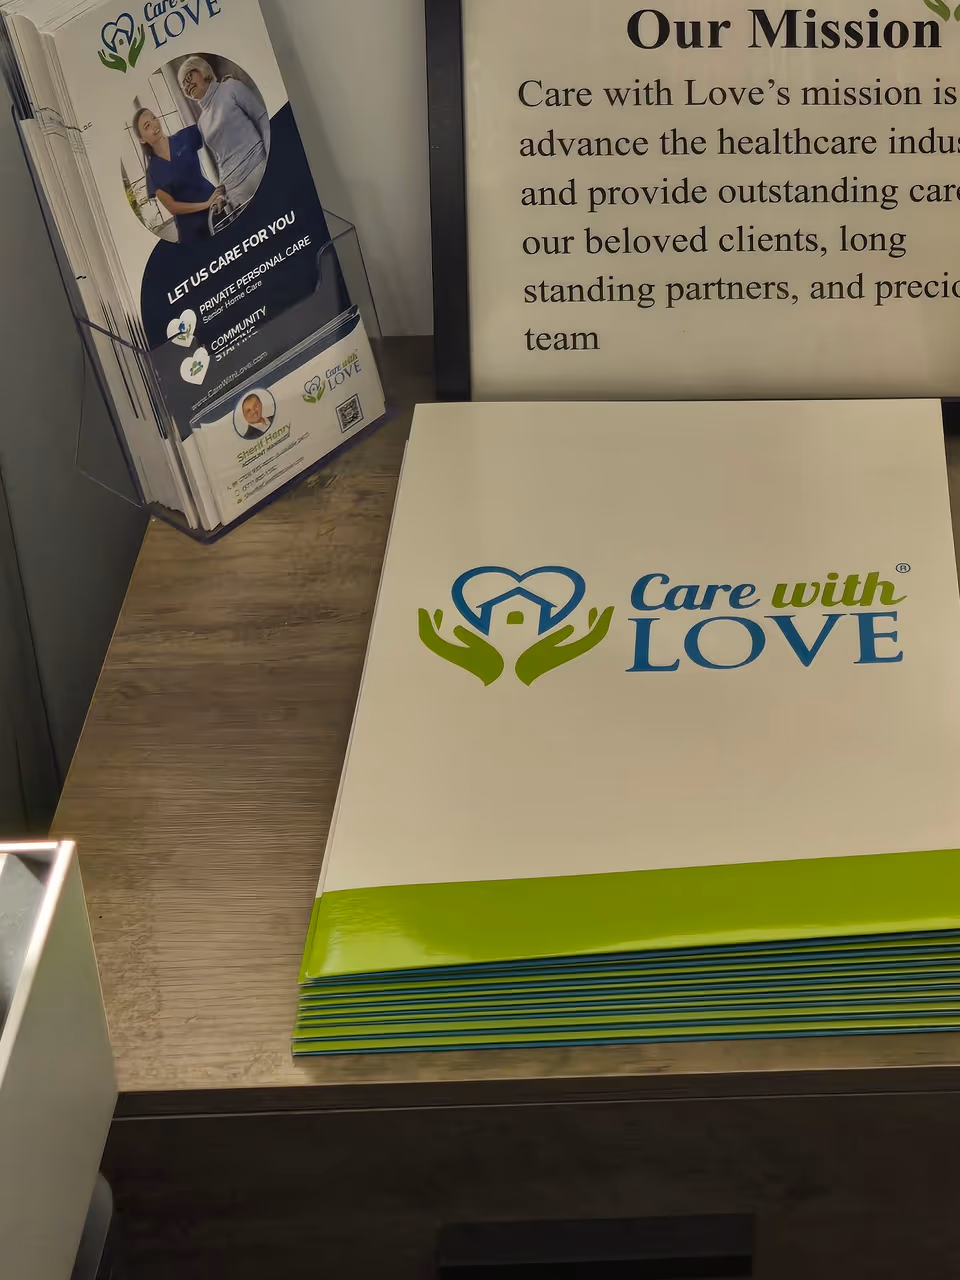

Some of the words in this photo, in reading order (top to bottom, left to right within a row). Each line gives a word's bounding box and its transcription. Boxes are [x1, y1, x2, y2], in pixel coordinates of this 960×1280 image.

[627, 9, 731, 49] Our
[747, 9, 942, 49] Mission
[518, 80, 592, 107] Care
[603, 79, 674, 106] with
[801, 78, 922, 105] mission
[933, 78, 957, 105] is
[520, 129, 648, 157] advance
[659, 128, 706, 155] the
[717, 128, 877, 155] healthcare
[521, 178, 578, 206] and
[587, 177, 707, 213] provide
[718, 176, 899, 210] outstanding
[167, 279, 189, 305] LET
[190, 267, 209, 287] US
[209, 244, 243, 274] CARE
[242, 228, 269, 253] FOR
[268, 210, 296, 236] YOU
[522, 236, 575, 255] our
[584, 225, 708, 254] beloved
[719, 225, 827, 257] clients,
[840, 225, 906, 258] long
[199, 283, 237, 315] PRIVATE
[236, 252, 287, 289] PERSONAL
[285, 235, 312, 257] CARE
[524, 276, 655, 309] standing
[665, 277, 798, 308] partners,
[810, 272, 865, 299] and
[202, 305, 224, 324] Senior
[224, 291, 246, 309] Home
[245, 280, 263, 294] Care
[210, 305, 267, 352] COMMUNITY
[524, 328, 600, 351] team
[328, 360, 362, 391] LOVE
[631, 573, 761, 610] Care
[771, 571, 907, 608] with
[625, 611, 903, 672] LOVE
